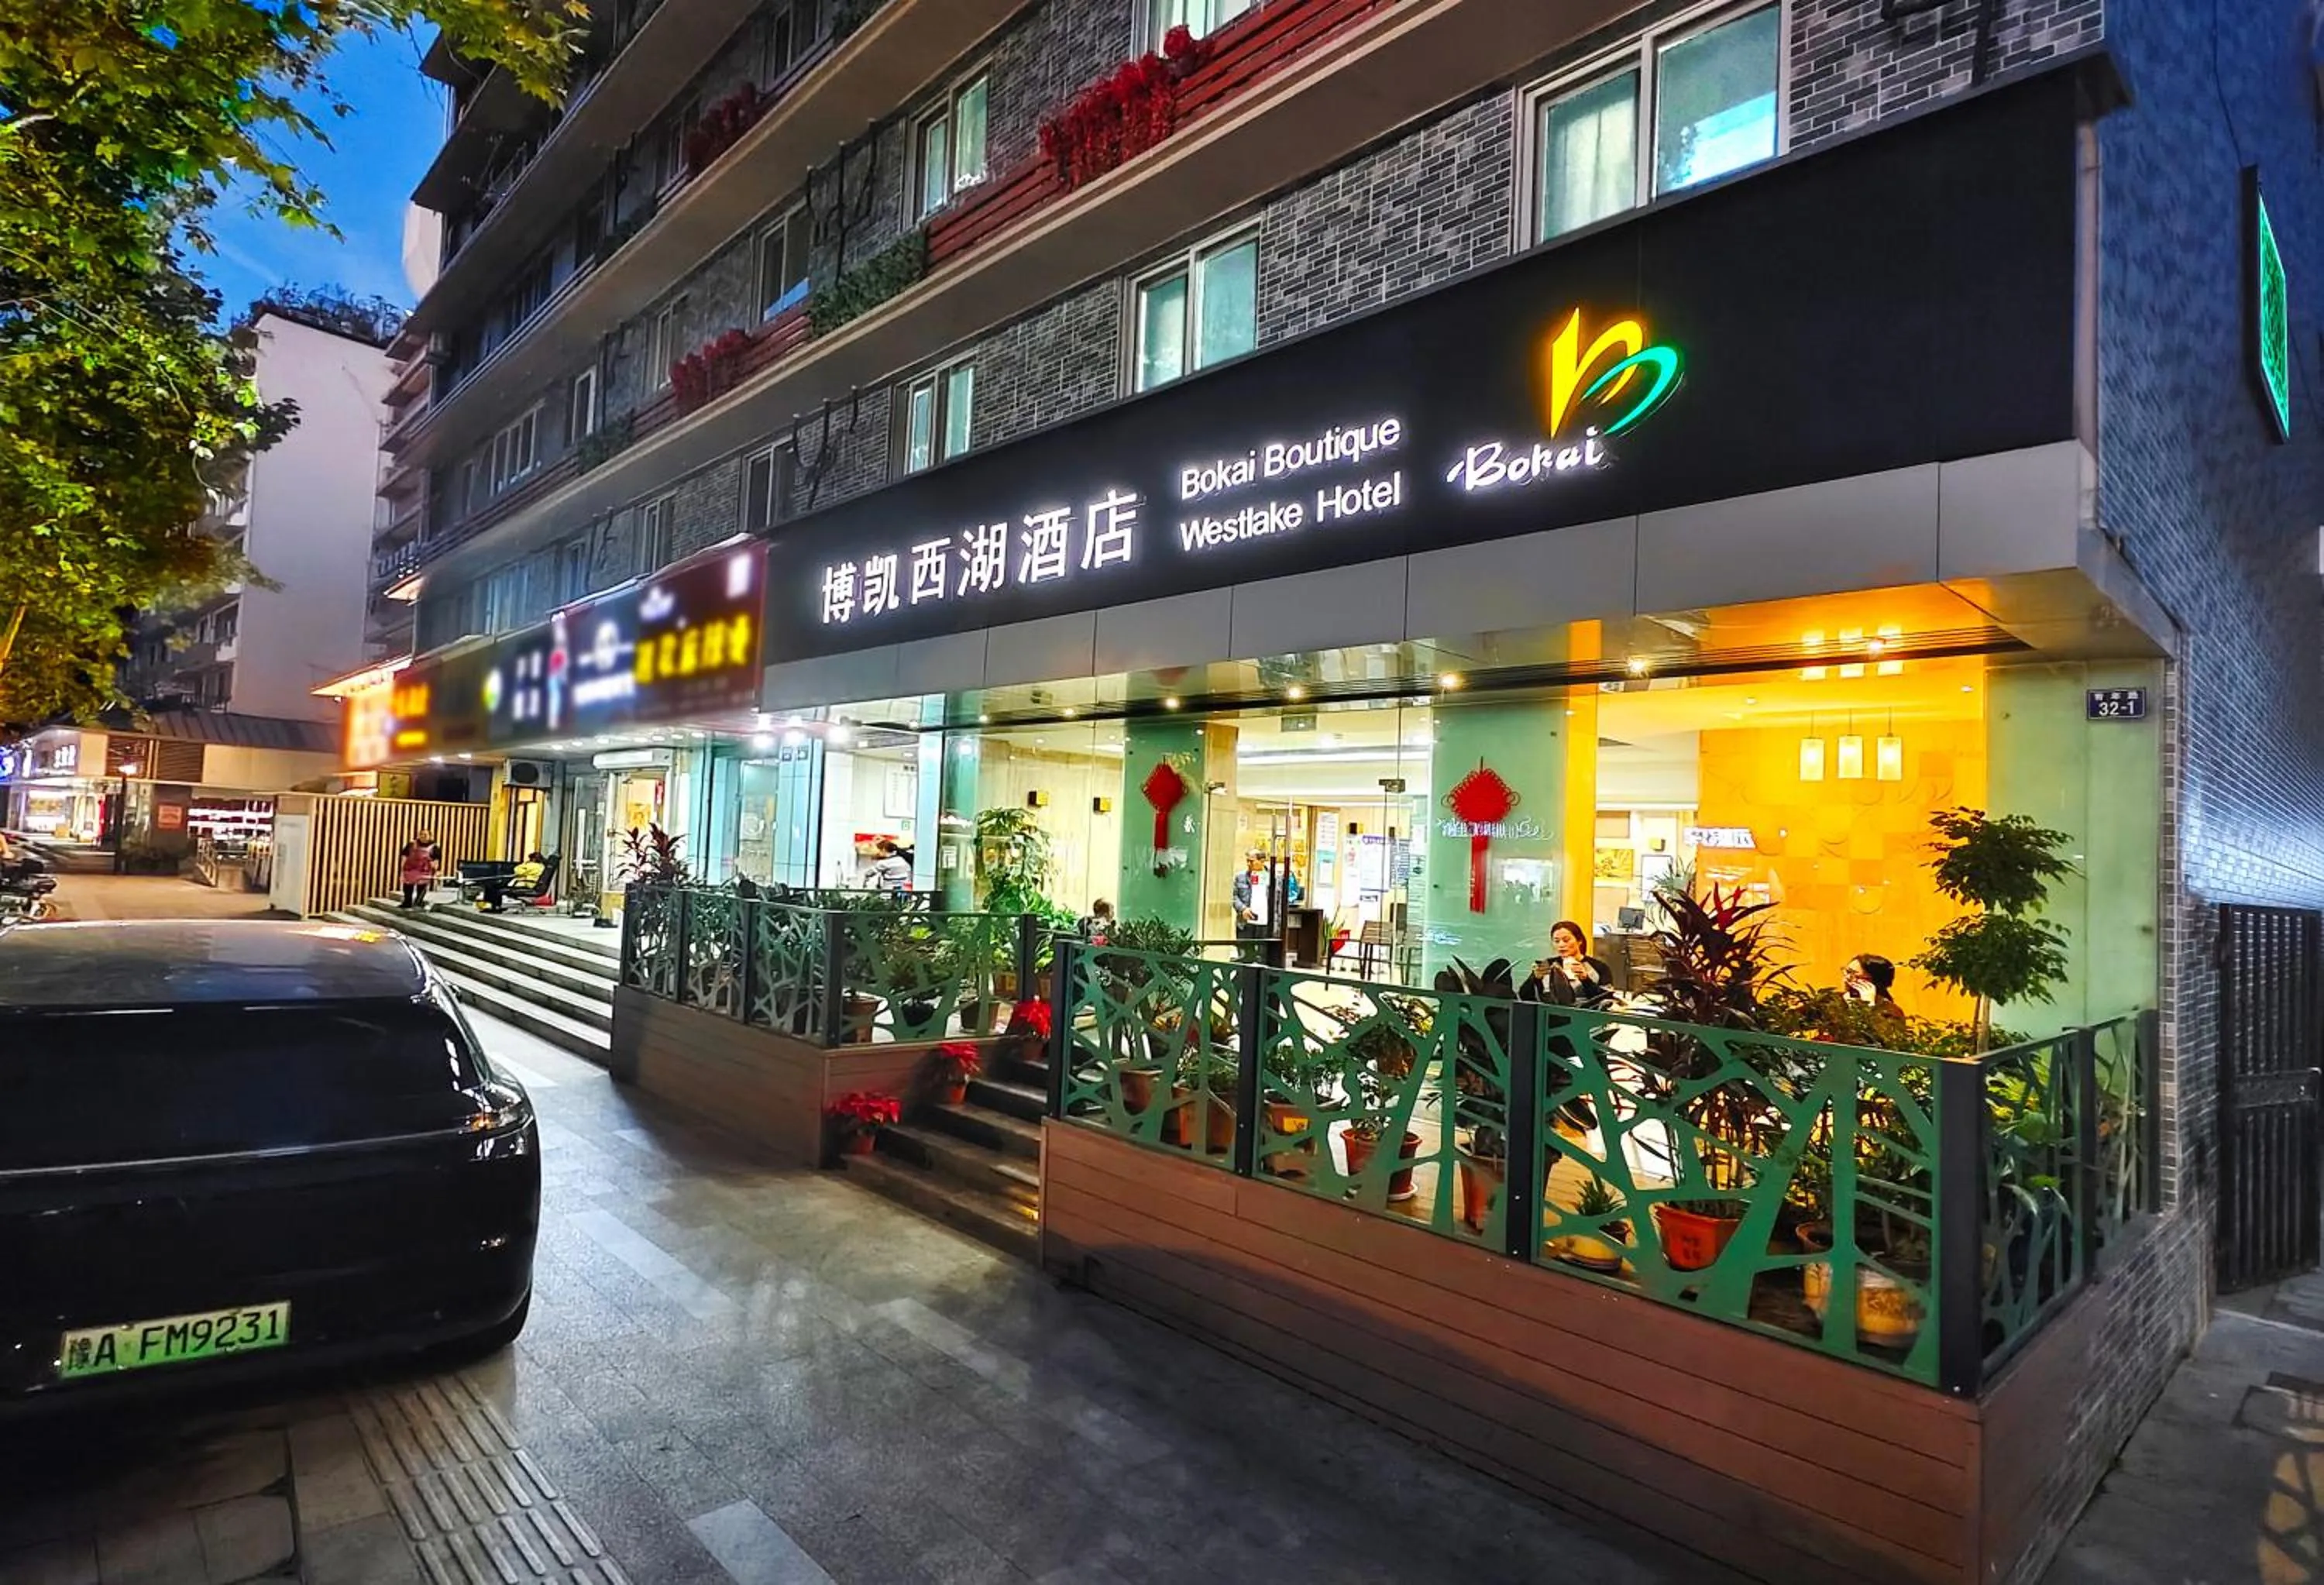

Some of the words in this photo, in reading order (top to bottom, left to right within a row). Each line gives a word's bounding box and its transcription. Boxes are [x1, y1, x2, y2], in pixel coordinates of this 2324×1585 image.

[1181, 450, 1256, 500] Bokai
[1264, 418, 1401, 477] Boutique
[1447, 425, 1604, 490] Bokai
[1180, 501, 1304, 552] Westlake
[1318, 471, 1401, 523] Hotel
[820, 490, 1137, 624] 博凯西湖酒店
[2099, 700, 2135, 716] 32-1
[139, 1309, 279, 1360] FM9231
